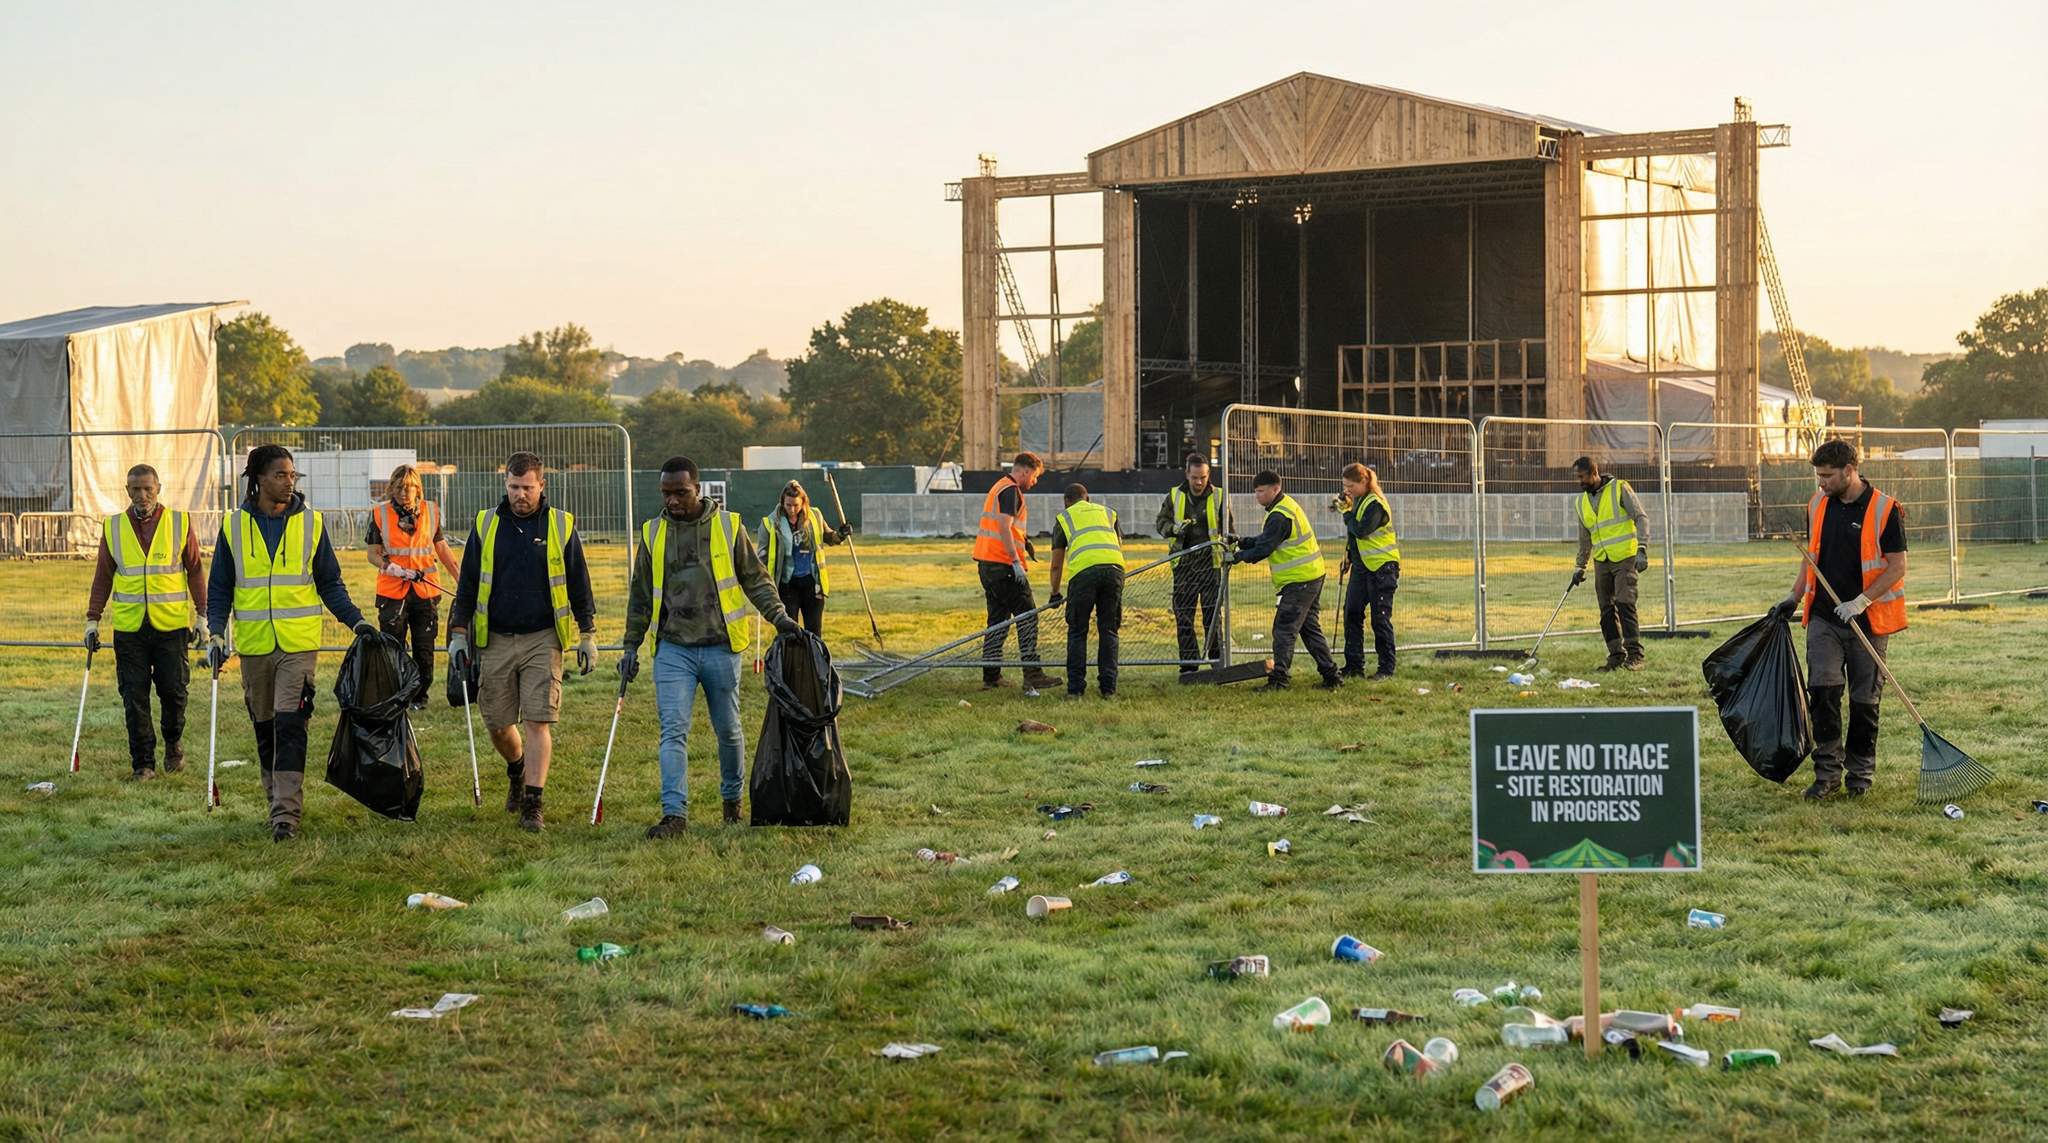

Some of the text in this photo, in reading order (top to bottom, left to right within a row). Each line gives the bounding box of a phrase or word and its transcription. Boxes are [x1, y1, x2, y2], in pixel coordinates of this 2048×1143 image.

[1495, 743, 1670, 771] LEAVE NO TRACE
[1507, 774, 1545, 797] SITE
[1548, 774, 1664, 797] RESTORATION
[1531, 799, 1641, 823] IN PROGRESS
